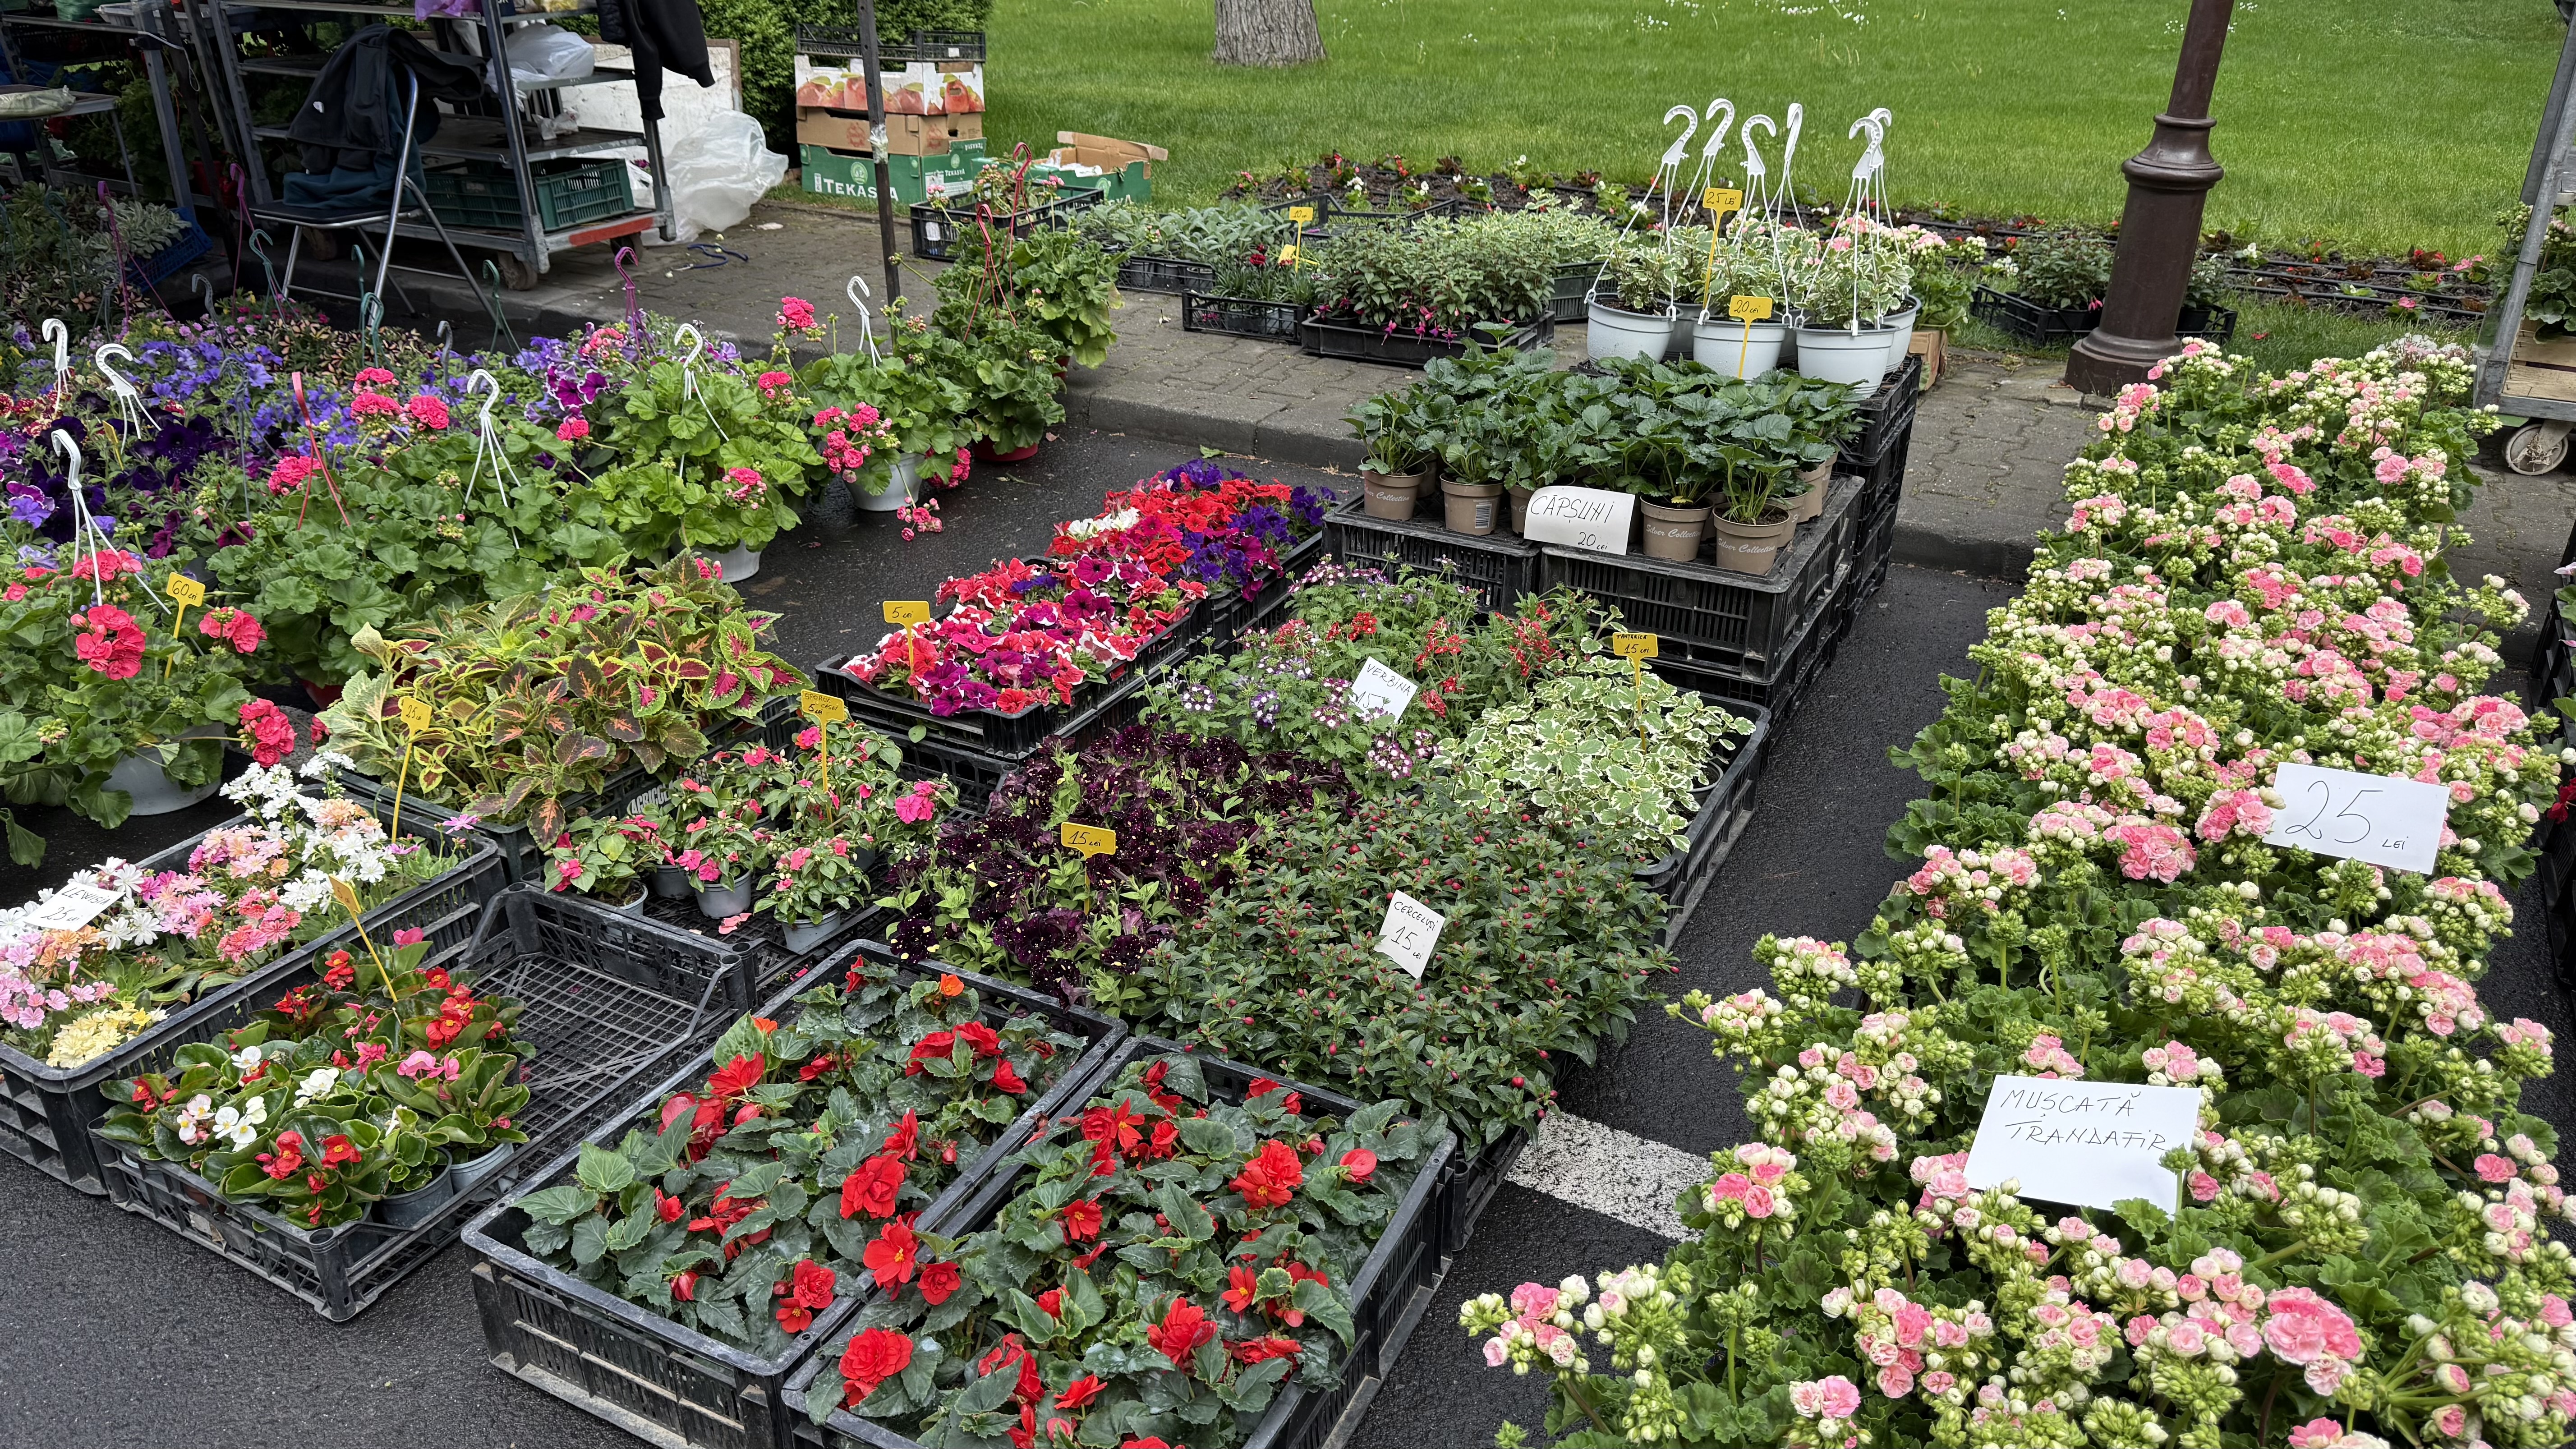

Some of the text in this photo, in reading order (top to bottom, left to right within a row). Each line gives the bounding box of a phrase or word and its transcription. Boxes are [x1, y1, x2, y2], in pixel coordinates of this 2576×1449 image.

[823, 178, 899, 201] TEKASA
[1706, 192, 1727, 204] 25
[1293, 210, 1302, 218] 10
[1734, 299, 1749, 313] 20
[1376, 492, 1410, 501] Collection
[1646, 524, 1665, 537] Silver
[1578, 531, 1596, 547] 20
[1718, 538, 1775, 554] Silver Collection
[172, 580, 189, 596] 60
[892, 606, 903, 618] 5
[1624, 644, 1639, 653] 15
[1367, 664, 1411, 696] VERBINA
[406, 704, 418, 718] 25
[2285, 780, 2383, 843] 25
[1067, 831, 1090, 845] 15
[61, 887, 110, 905] LEWISIA
[41, 906, 75, 920] 25
[1391, 926, 1418, 950] 15
[2005, 1120, 2167, 1150] TRANDAFIR
